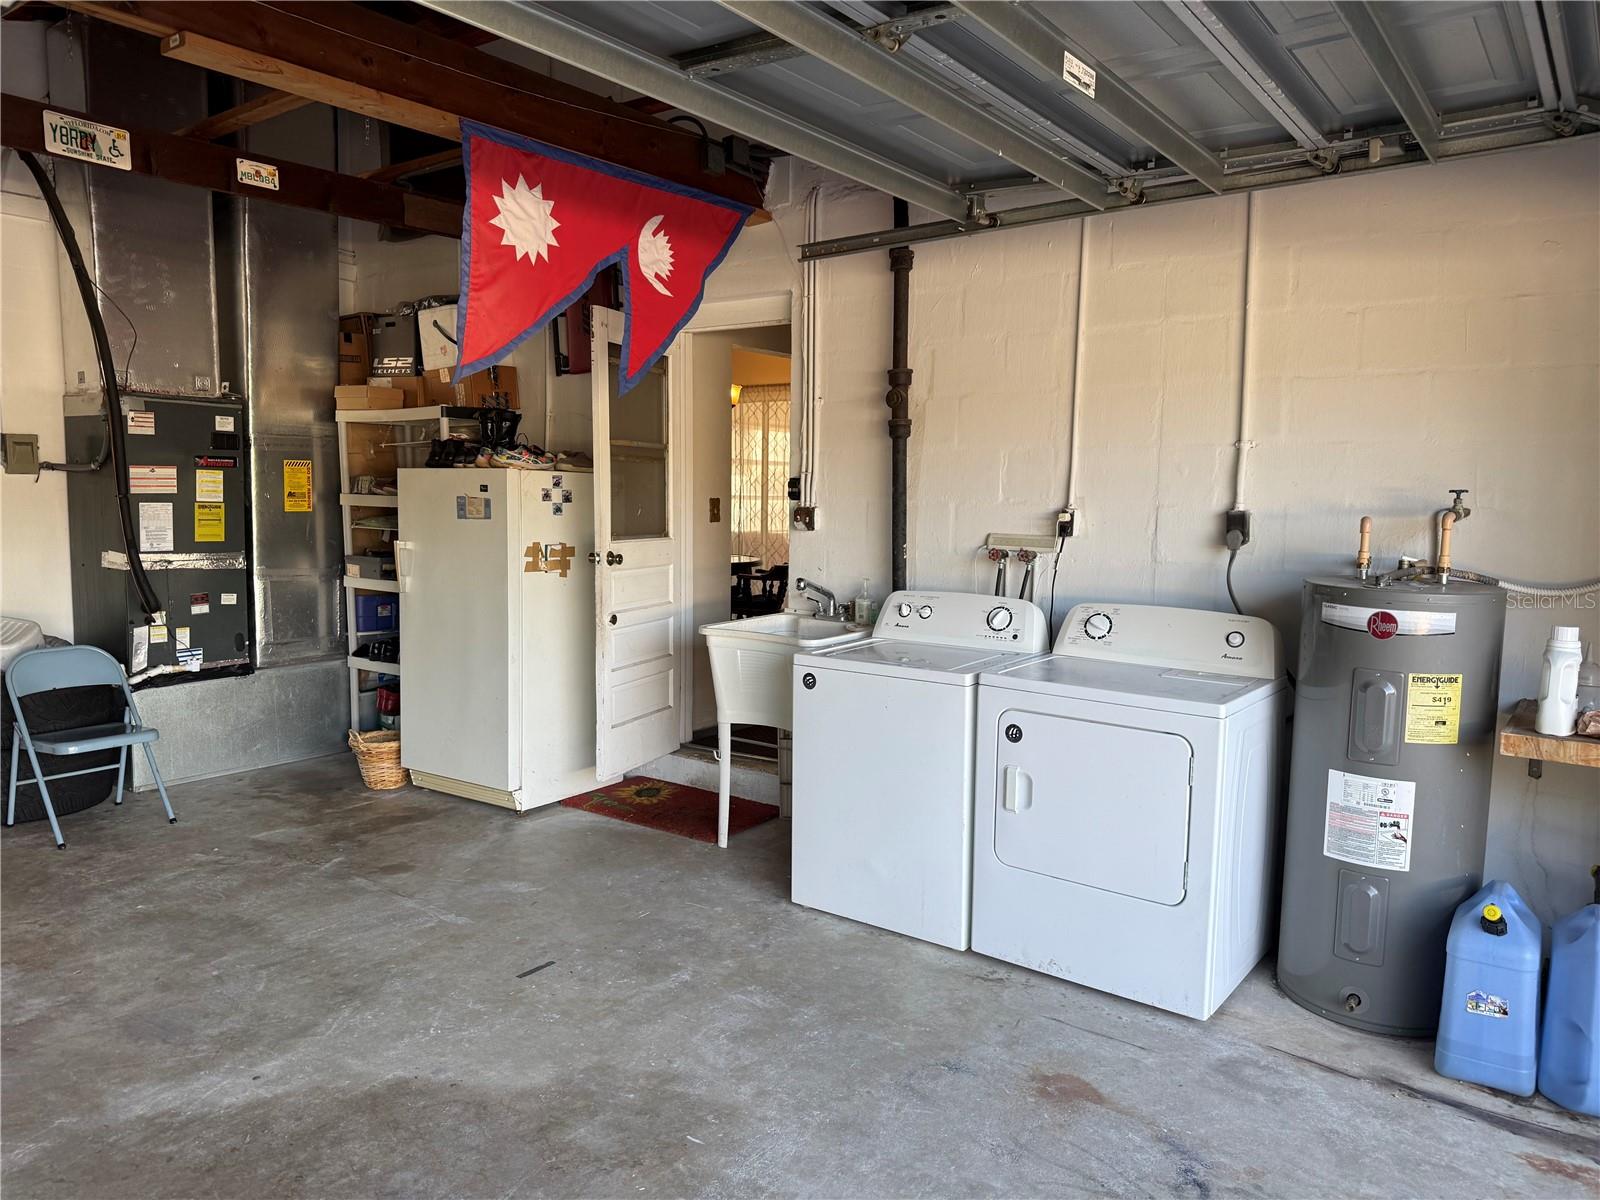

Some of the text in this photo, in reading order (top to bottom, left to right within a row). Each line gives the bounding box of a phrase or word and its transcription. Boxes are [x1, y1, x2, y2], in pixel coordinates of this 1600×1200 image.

[66, 147, 93, 160] SUNSHINE
[373, 357, 414, 367] LS2
[1369, 611, 1397, 636] Rheem
[1411, 676, 1459, 685] ENERGYGUIDE
